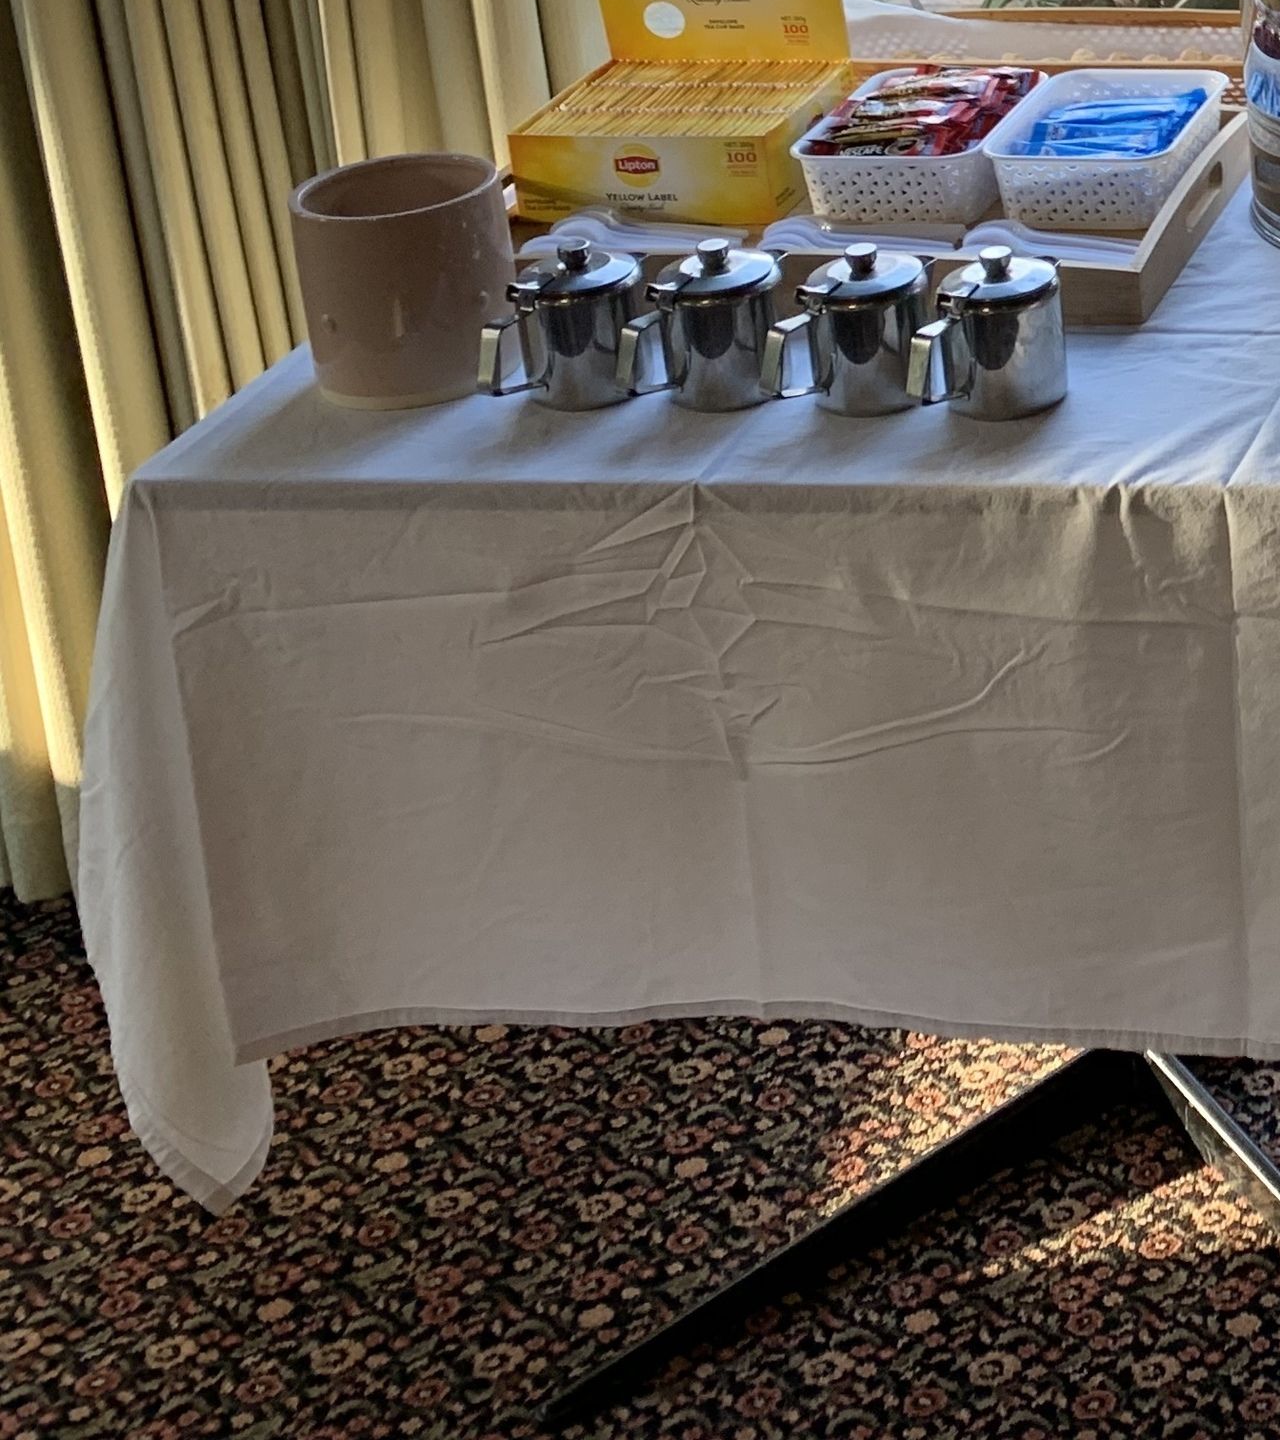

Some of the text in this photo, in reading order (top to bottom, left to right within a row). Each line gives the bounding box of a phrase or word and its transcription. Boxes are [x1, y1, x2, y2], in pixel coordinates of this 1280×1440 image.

[784, 25, 809, 34] 100
[726, 151, 757, 163] 100
[618, 159, 656, 172] Lipton
[605, 192, 679, 201] YELLOW LABEL
